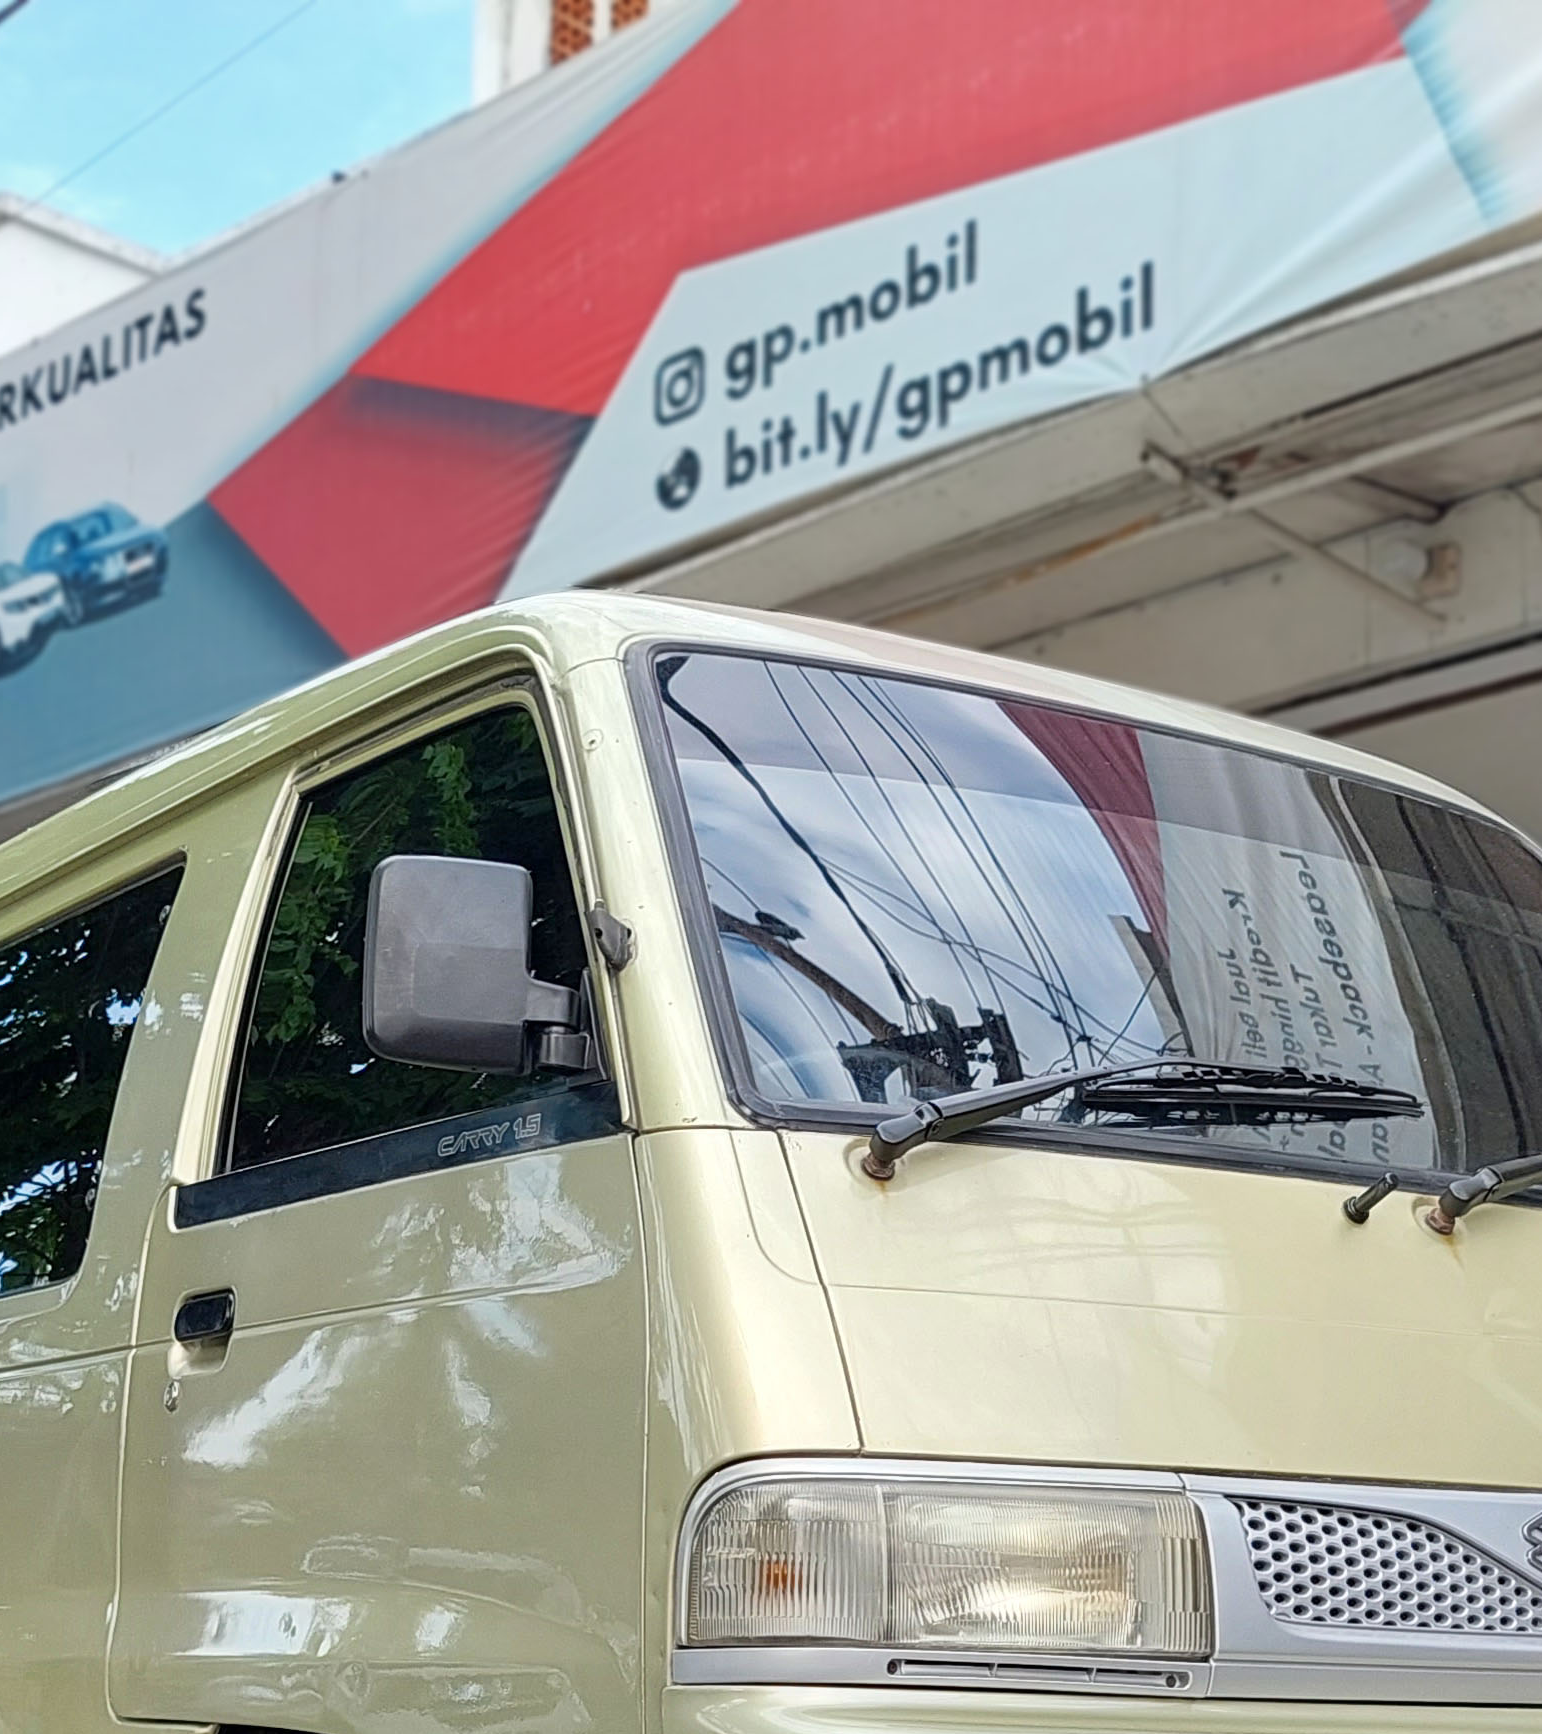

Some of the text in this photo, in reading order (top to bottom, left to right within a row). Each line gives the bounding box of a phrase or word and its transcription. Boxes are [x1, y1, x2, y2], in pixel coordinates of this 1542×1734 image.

[724, 218, 979, 401] gp.mobil
[724, 260, 1156, 490] bit.ly/gpmobil
[437, 1112, 542, 1157] CARRY 1.5
